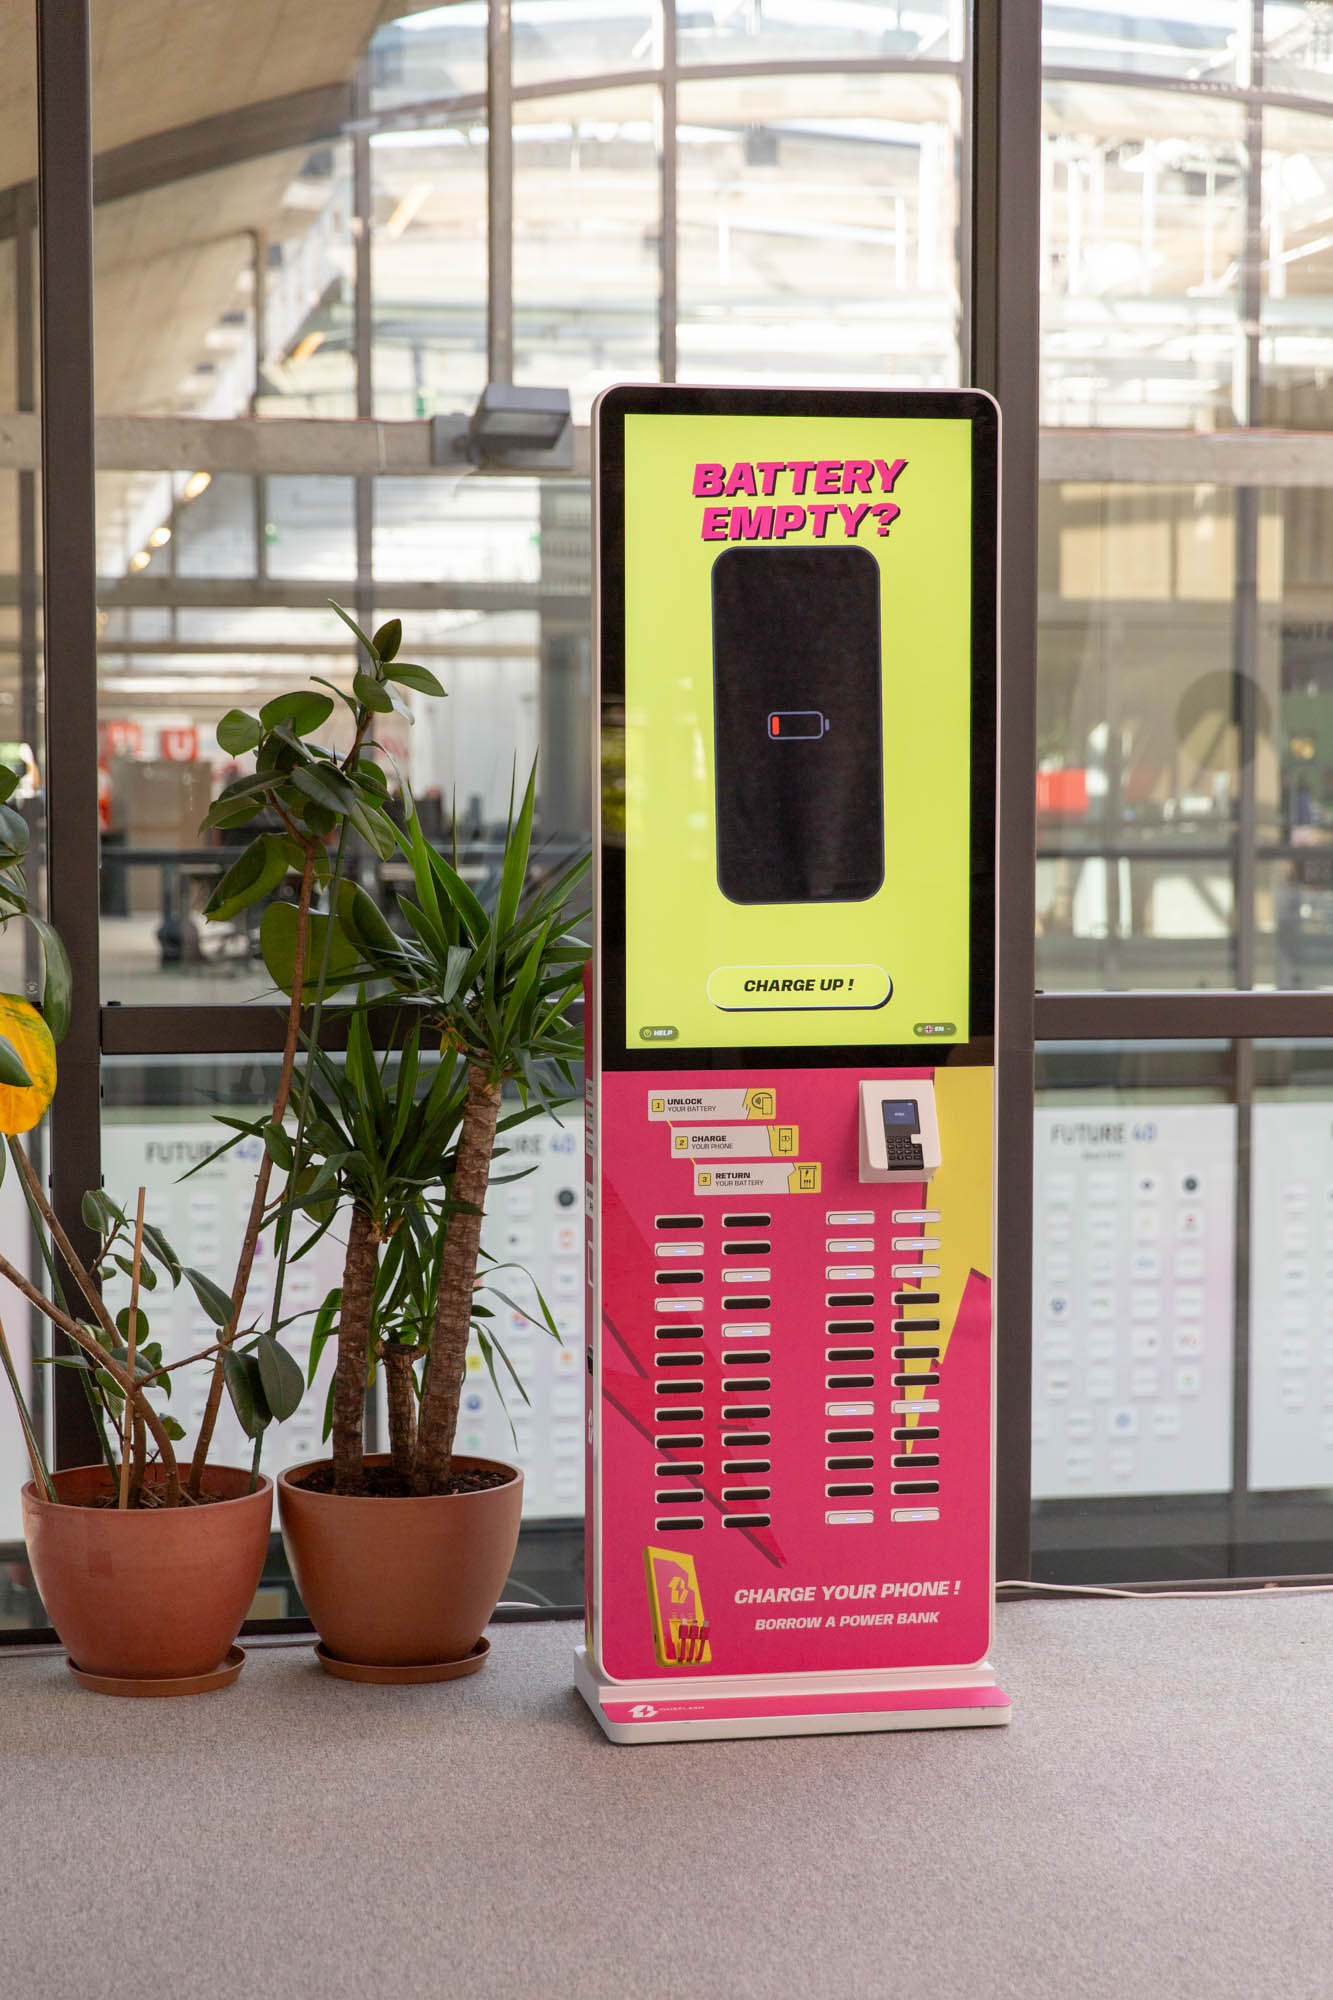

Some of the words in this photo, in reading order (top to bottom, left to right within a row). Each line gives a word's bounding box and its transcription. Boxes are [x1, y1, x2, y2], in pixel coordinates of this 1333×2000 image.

[692, 459, 909, 498] BATTERY
[701, 502, 901, 541] EMPTY?
[744, 979, 816, 992] CHARGE
[820, 979, 844, 991] UP
[734, 1586, 816, 1604] CHARGE
[821, 1583, 876, 1600] YOUR
[881, 1581, 950, 1598] PHONE
[755, 1616, 822, 1631] BORROW
[825, 1616, 836, 1627] A
[840, 1613, 893, 1627] POWER
[897, 1612, 940, 1624] BANK
